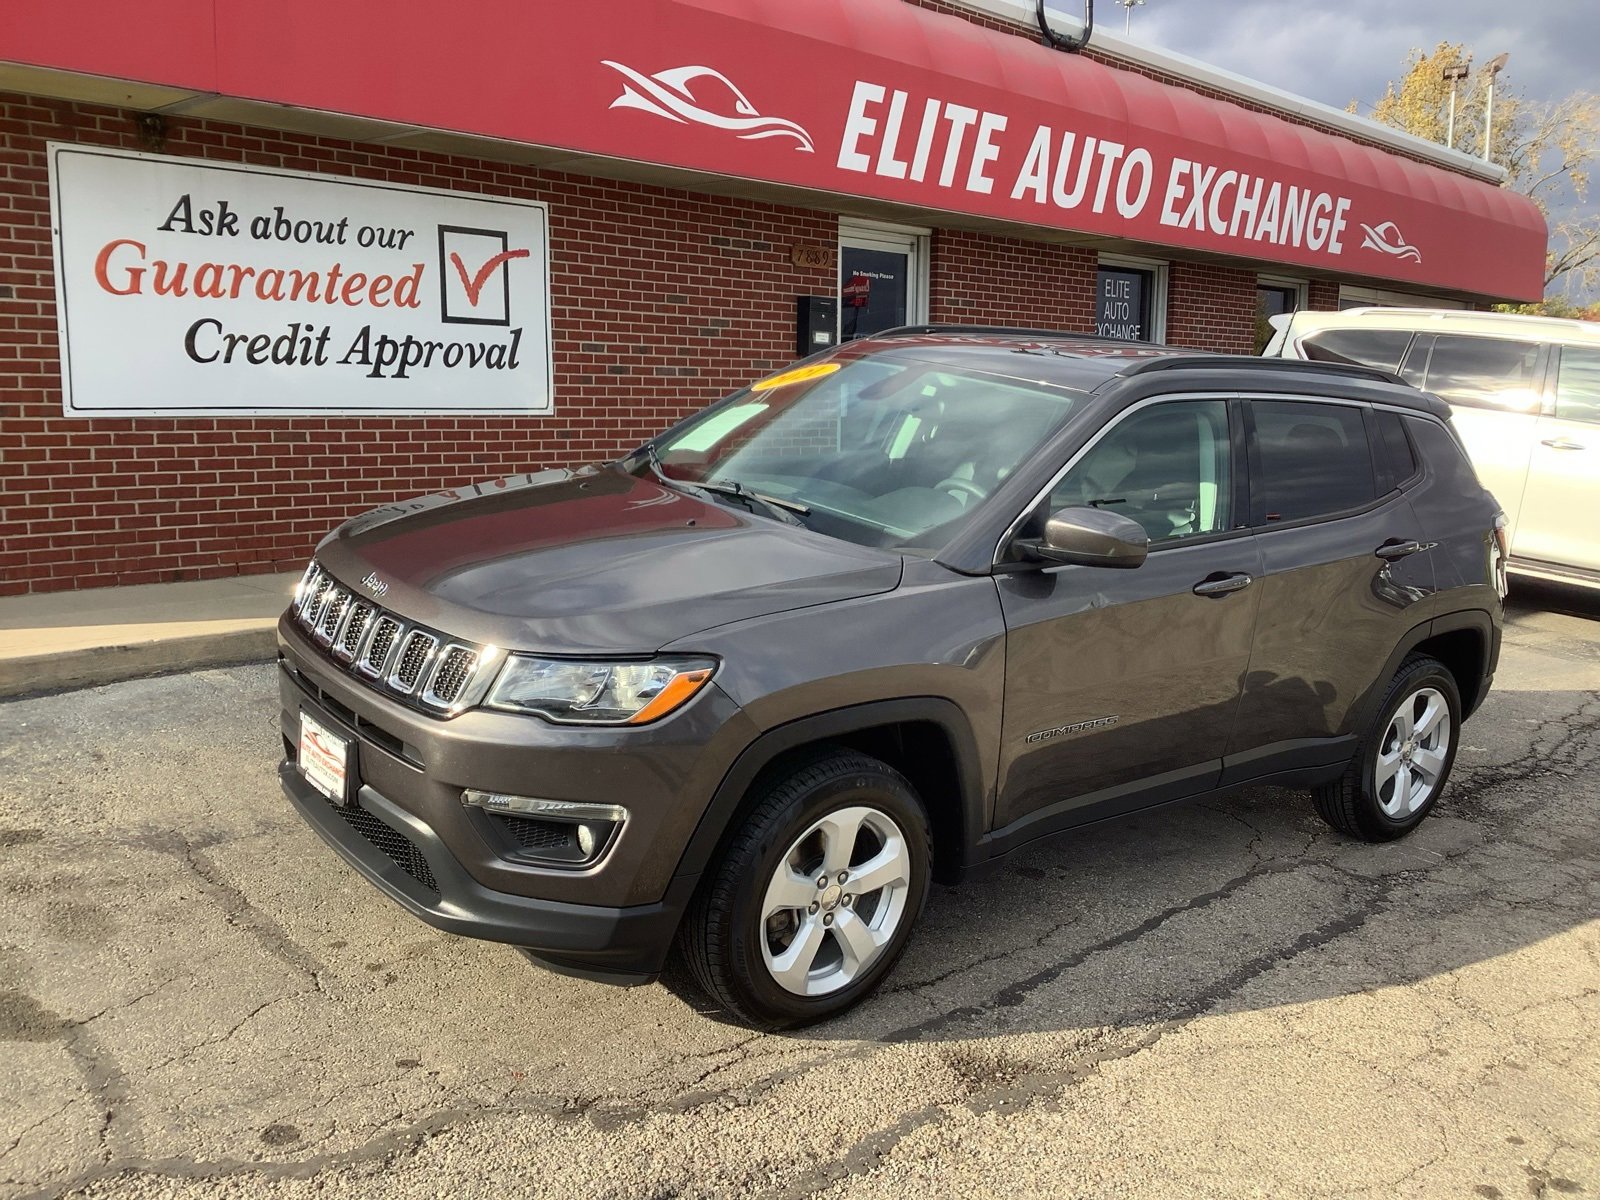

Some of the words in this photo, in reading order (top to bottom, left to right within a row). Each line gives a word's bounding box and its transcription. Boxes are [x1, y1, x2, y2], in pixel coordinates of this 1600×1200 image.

[837, 80, 1008, 195] ELITE
[1010, 125, 1154, 219] AUTO
[1159, 157, 1352, 255] EXCHANGE
[157, 193, 240, 237] Ask
[250, 206, 348, 246] about
[356, 227, 415, 250] our
[797, 249, 829, 266] 7889
[94, 238, 425, 309] Guaranteed
[860, 271, 879, 279] Smoking
[1105, 279, 1130, 298] ELITE
[1103, 301, 1129, 320] AUTO
[1094, 322, 1141, 340] XCHANGE
[184, 317, 331, 367] Credit
[336, 327, 523, 379] Approval
[360, 571, 388, 597] Jeep
[1025, 715, 1119, 744] COMPASS
